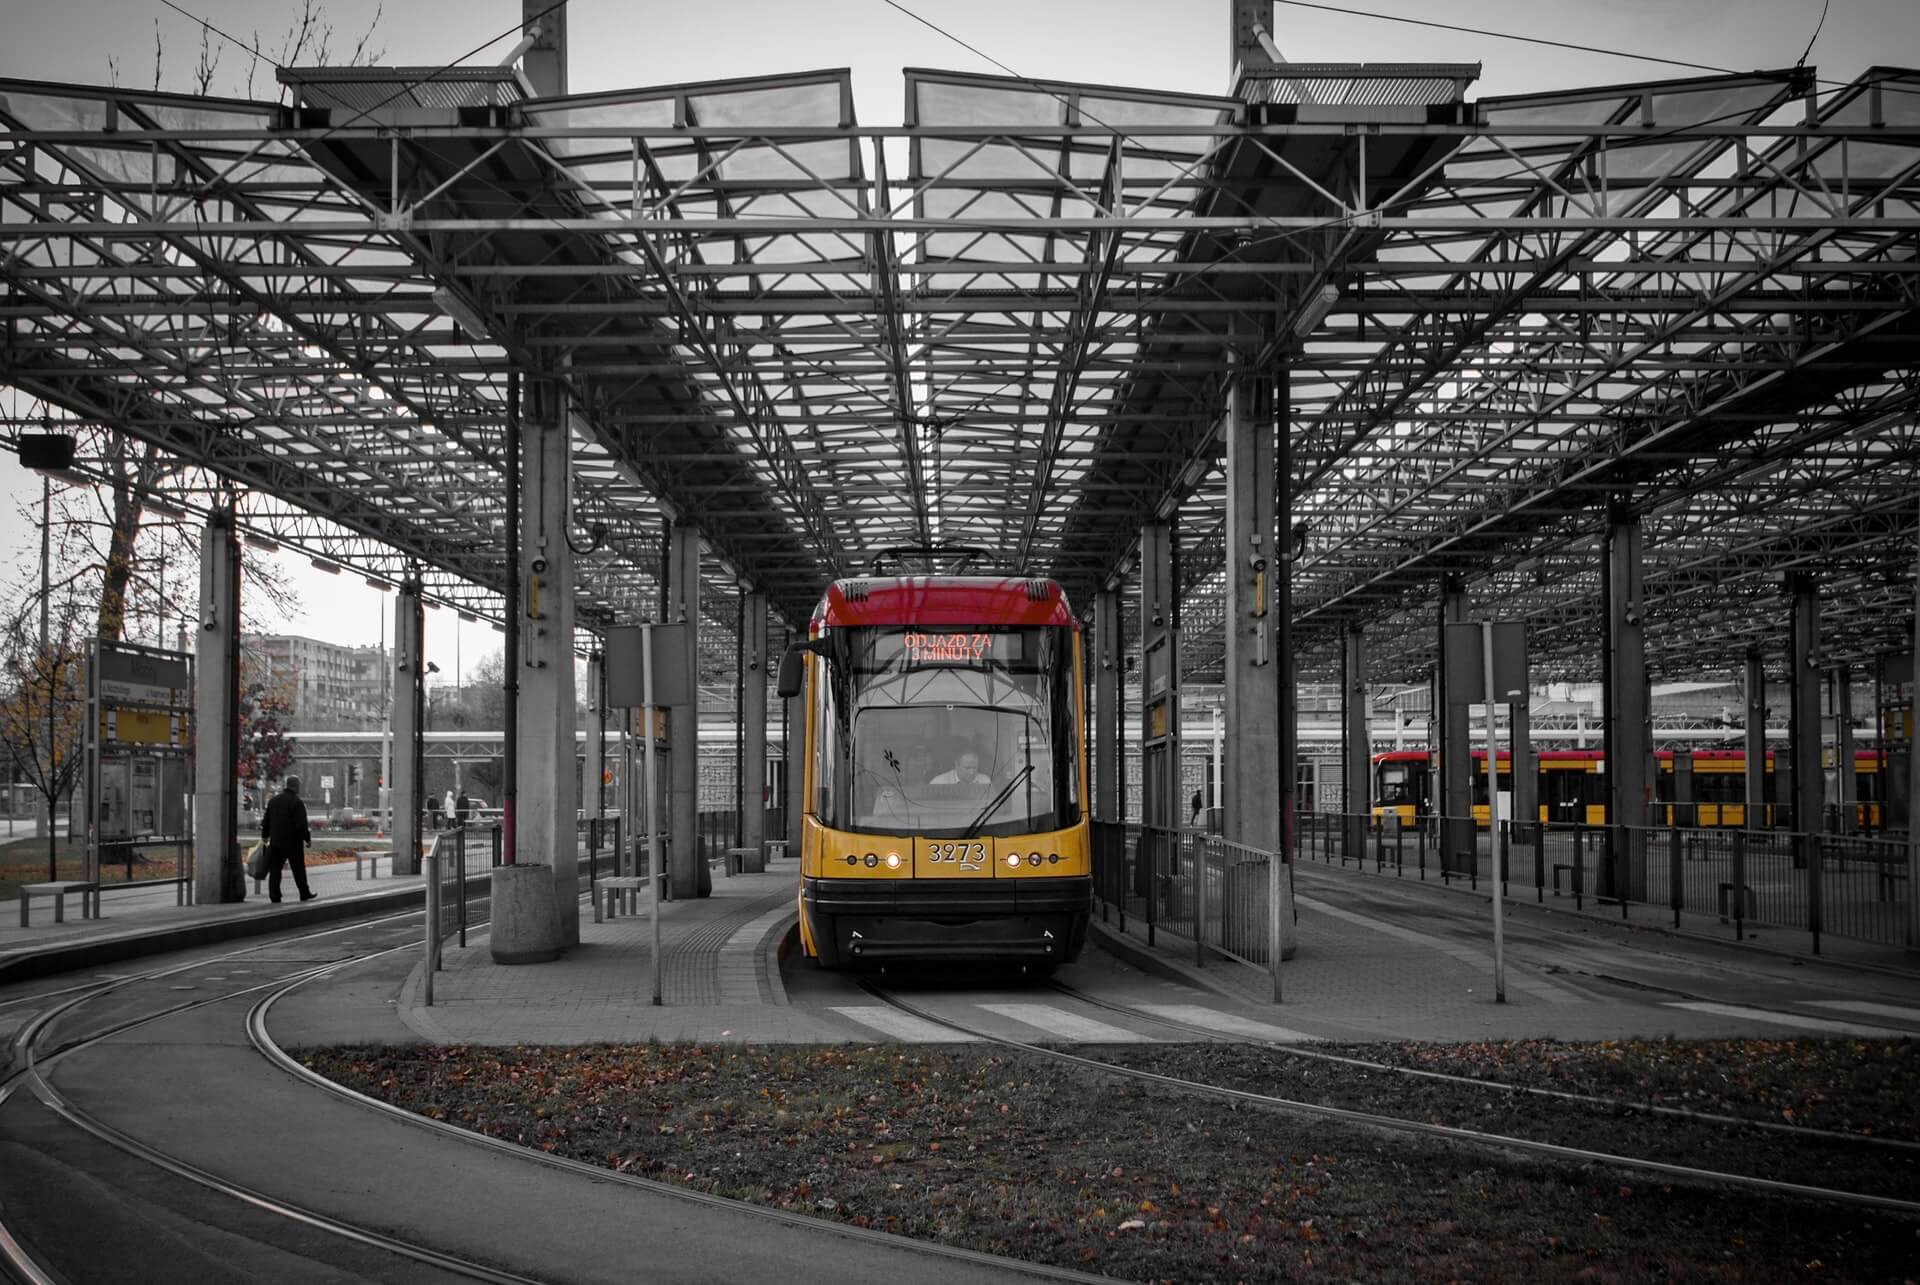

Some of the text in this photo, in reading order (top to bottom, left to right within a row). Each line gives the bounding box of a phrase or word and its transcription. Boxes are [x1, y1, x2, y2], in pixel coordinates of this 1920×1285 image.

[904, 634, 992, 648] ODJAZD ZA
[912, 647, 983, 660] 3 MINUTY
[928, 843, 986, 863] 3273
